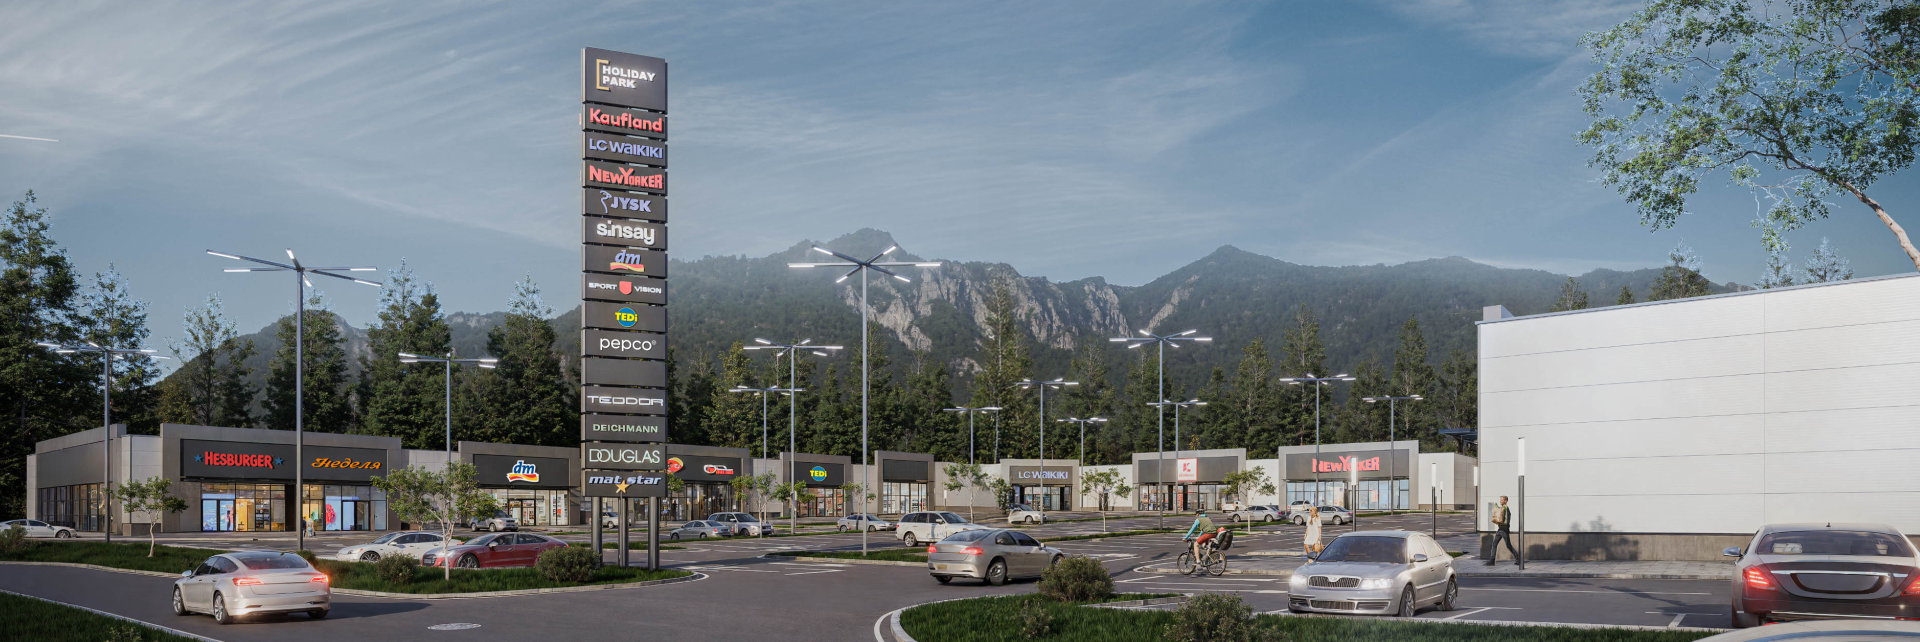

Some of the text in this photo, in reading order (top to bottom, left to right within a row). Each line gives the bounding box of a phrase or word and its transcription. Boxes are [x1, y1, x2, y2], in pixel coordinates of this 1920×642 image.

[602, 65, 656, 82] HOLIDAY
[602, 75, 636, 89] PARK
[589, 107, 663, 132] Kaufland
[589, 138, 608, 151] LC
[610, 197, 651, 213] JYSK
[596, 220, 655, 246] sinsay
[614, 249, 641, 265] dm
[588, 282, 662, 294] SPORT VISION
[615, 312, 637, 322] TEDi
[586, 395, 664, 407] TEODOR
[592, 423, 658, 433] DEICHMANN
[204, 451, 274, 470] HESBURGER
[589, 448, 661, 464] DOUGLAS
[311, 457, 382, 470] Неделя
[513, 461, 535, 474] dm
[588, 475, 662, 485] mat star
[809, 469, 828, 478] TEDi
[1018, 471, 1031, 479] LC
